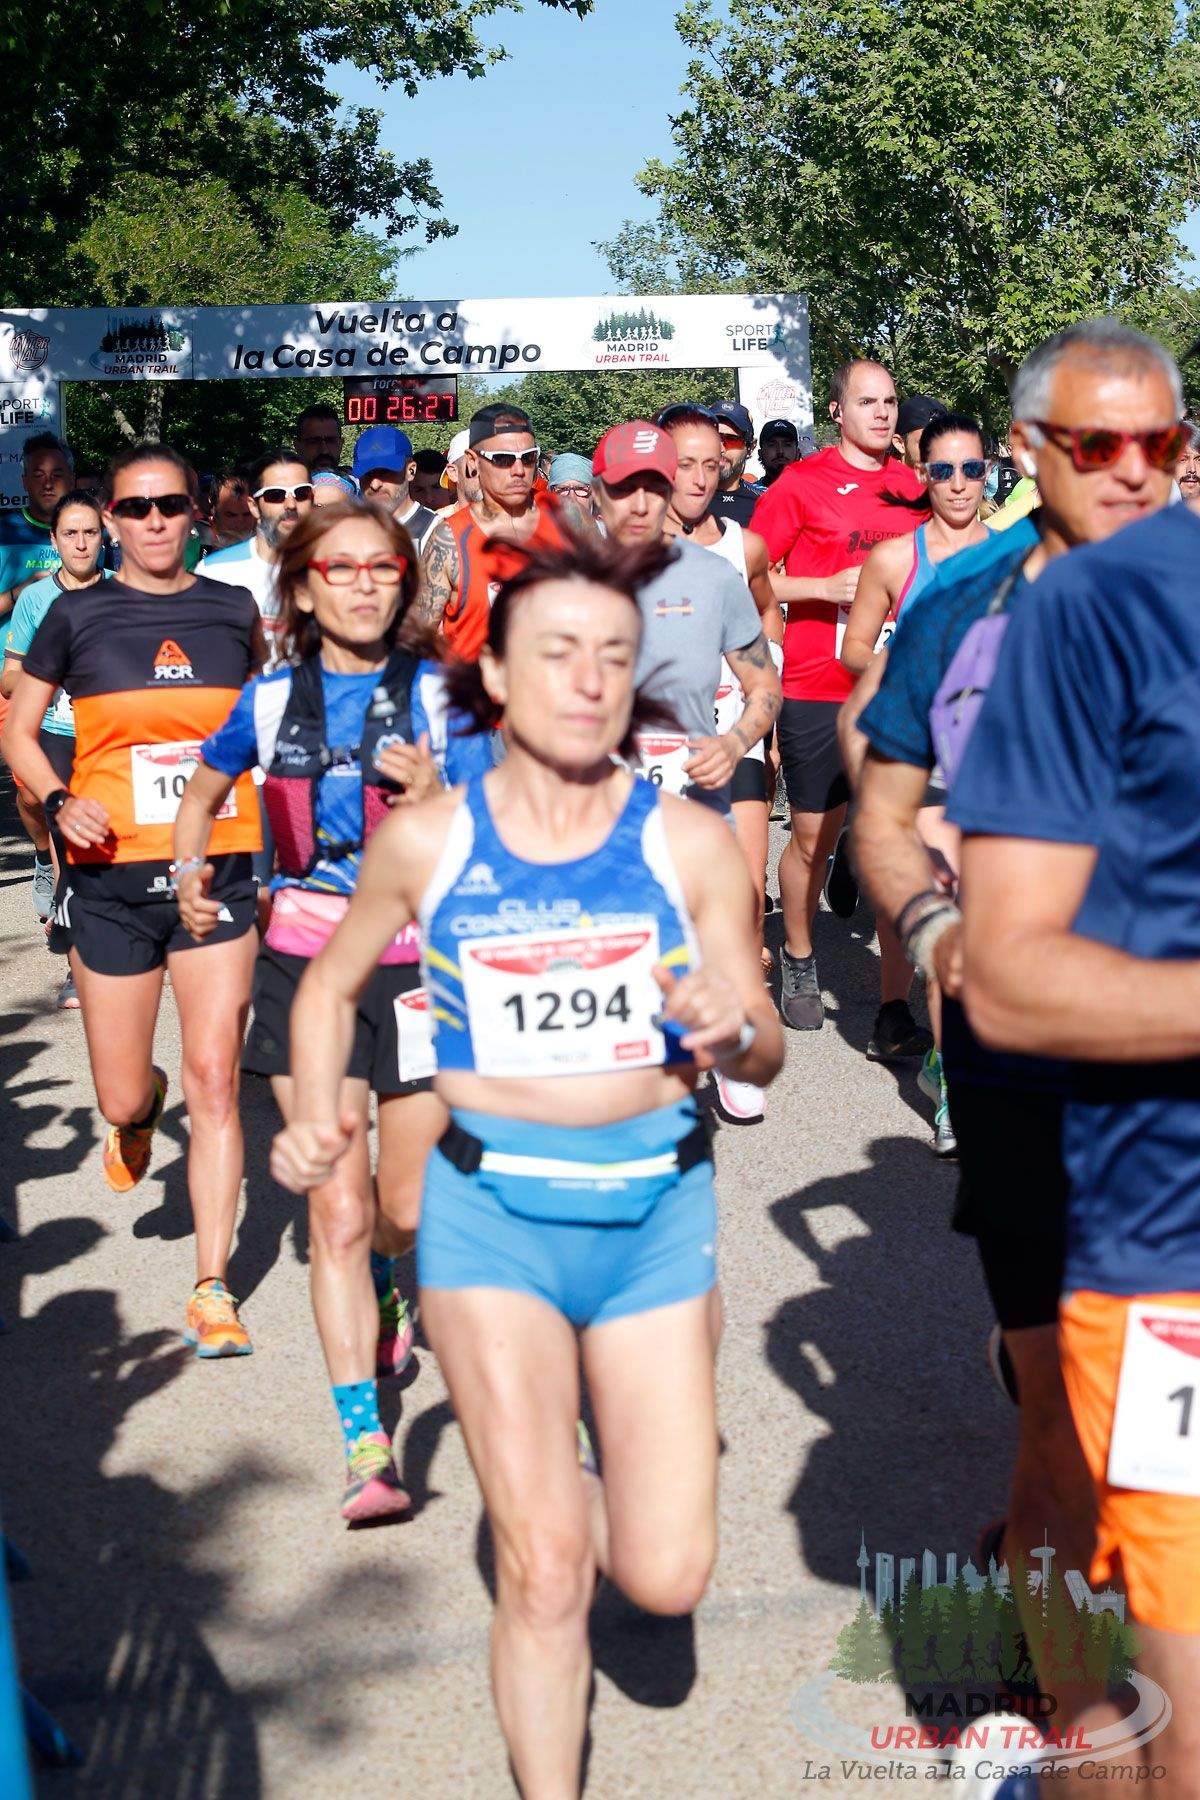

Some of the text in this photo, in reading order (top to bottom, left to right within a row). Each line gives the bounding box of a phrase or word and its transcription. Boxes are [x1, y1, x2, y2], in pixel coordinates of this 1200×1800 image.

[315, 308, 457, 333] Vuelta a
[726, 324, 773, 337] SPORT
[606, 343, 658, 353] MADRID
[733, 338, 767, 351] LIFE
[115, 354, 168, 364] MADRID
[233, 341, 541, 369] la Casa de Campo
[595, 353, 670, 363] URBAN TRAIL
[104, 365, 179, 375] URBAN TRAIL
[0, 399, 39, 411] PORT
[348, 394, 455, 421] 00 26:27
[0, 411, 34, 424] LIFE
[504, 984, 632, 1033] 1294
